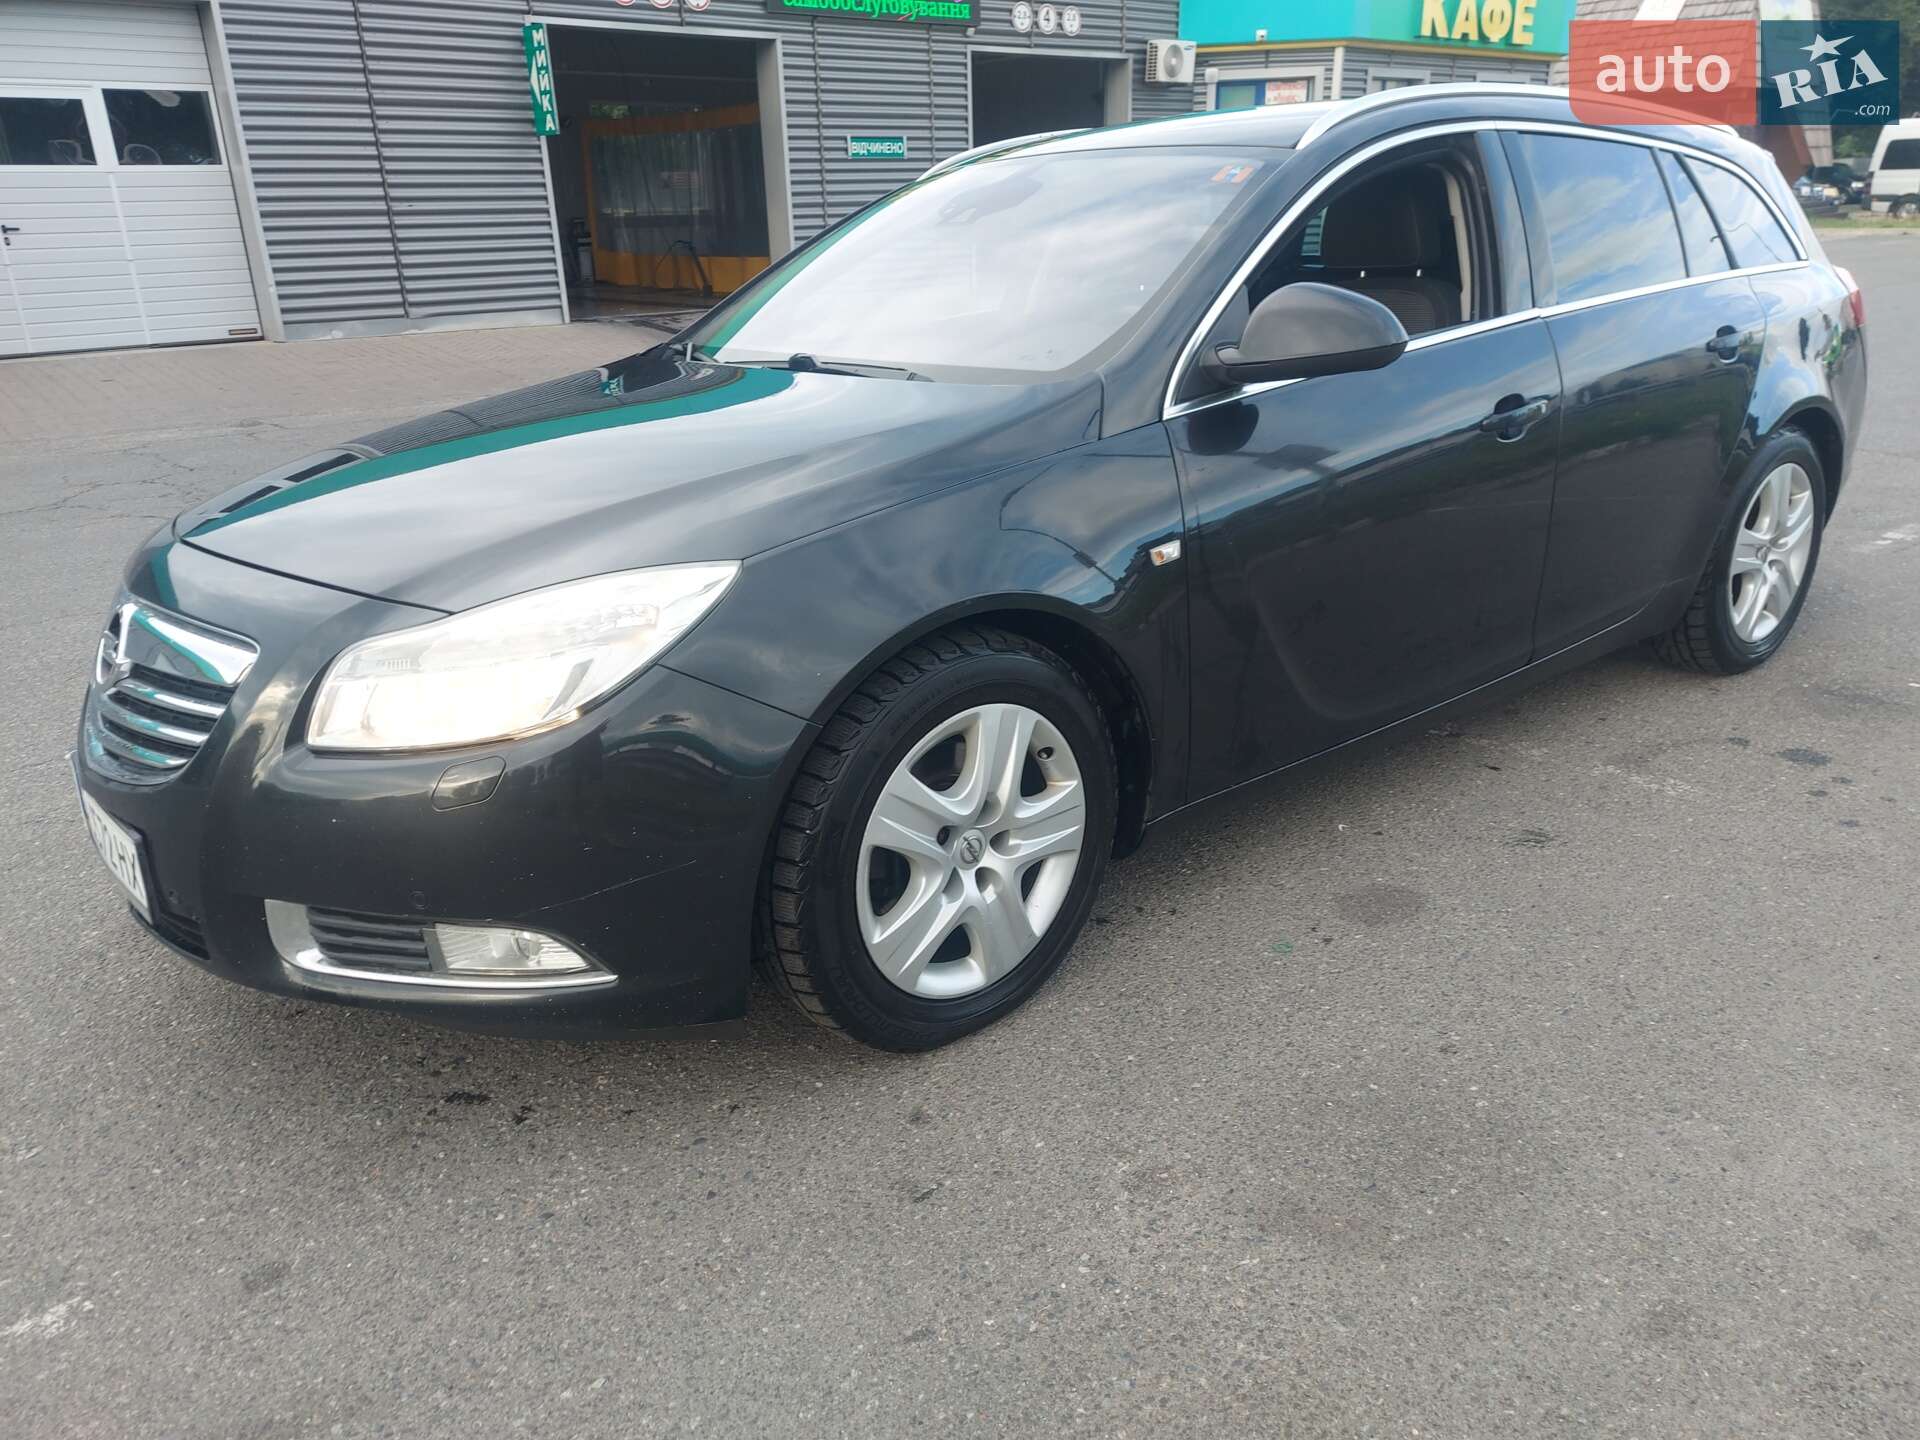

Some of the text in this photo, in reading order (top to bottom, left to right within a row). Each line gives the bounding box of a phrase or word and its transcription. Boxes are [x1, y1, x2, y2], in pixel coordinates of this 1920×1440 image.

[1420, 0, 1536, 45] КАФЕ
[532, 28, 556, 131] МИЙКА
[851, 142, 904, 156] ВІДЧИНЕНО
